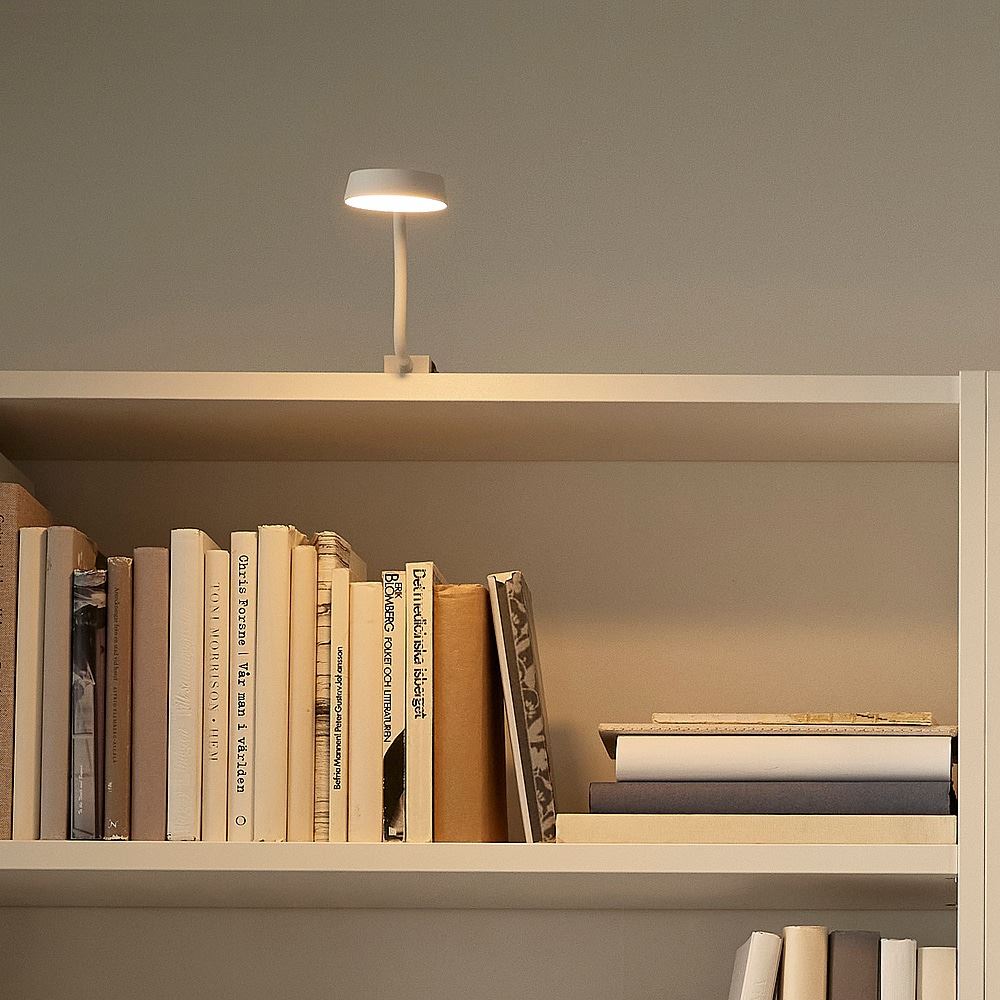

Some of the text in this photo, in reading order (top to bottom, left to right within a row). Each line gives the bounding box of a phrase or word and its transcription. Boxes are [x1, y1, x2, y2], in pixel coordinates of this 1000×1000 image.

[238, 554, 249, 594] Chris
[394, 582, 402, 599] ERIK
[383, 573, 399, 632] BLOMBERG
[237, 598, 249, 646] Forsne
[384, 637, 392, 666] FOLKET
[412, 568, 427, 720] Det medicinska isberget
[208, 582, 221, 762] TONI MORRISON HEM
[237, 662, 251, 687] Vår
[384, 667, 392, 687] OCH
[237, 693, 246, 717] man
[334, 713, 342, 732] Peter
[235, 737, 248, 793] världen
